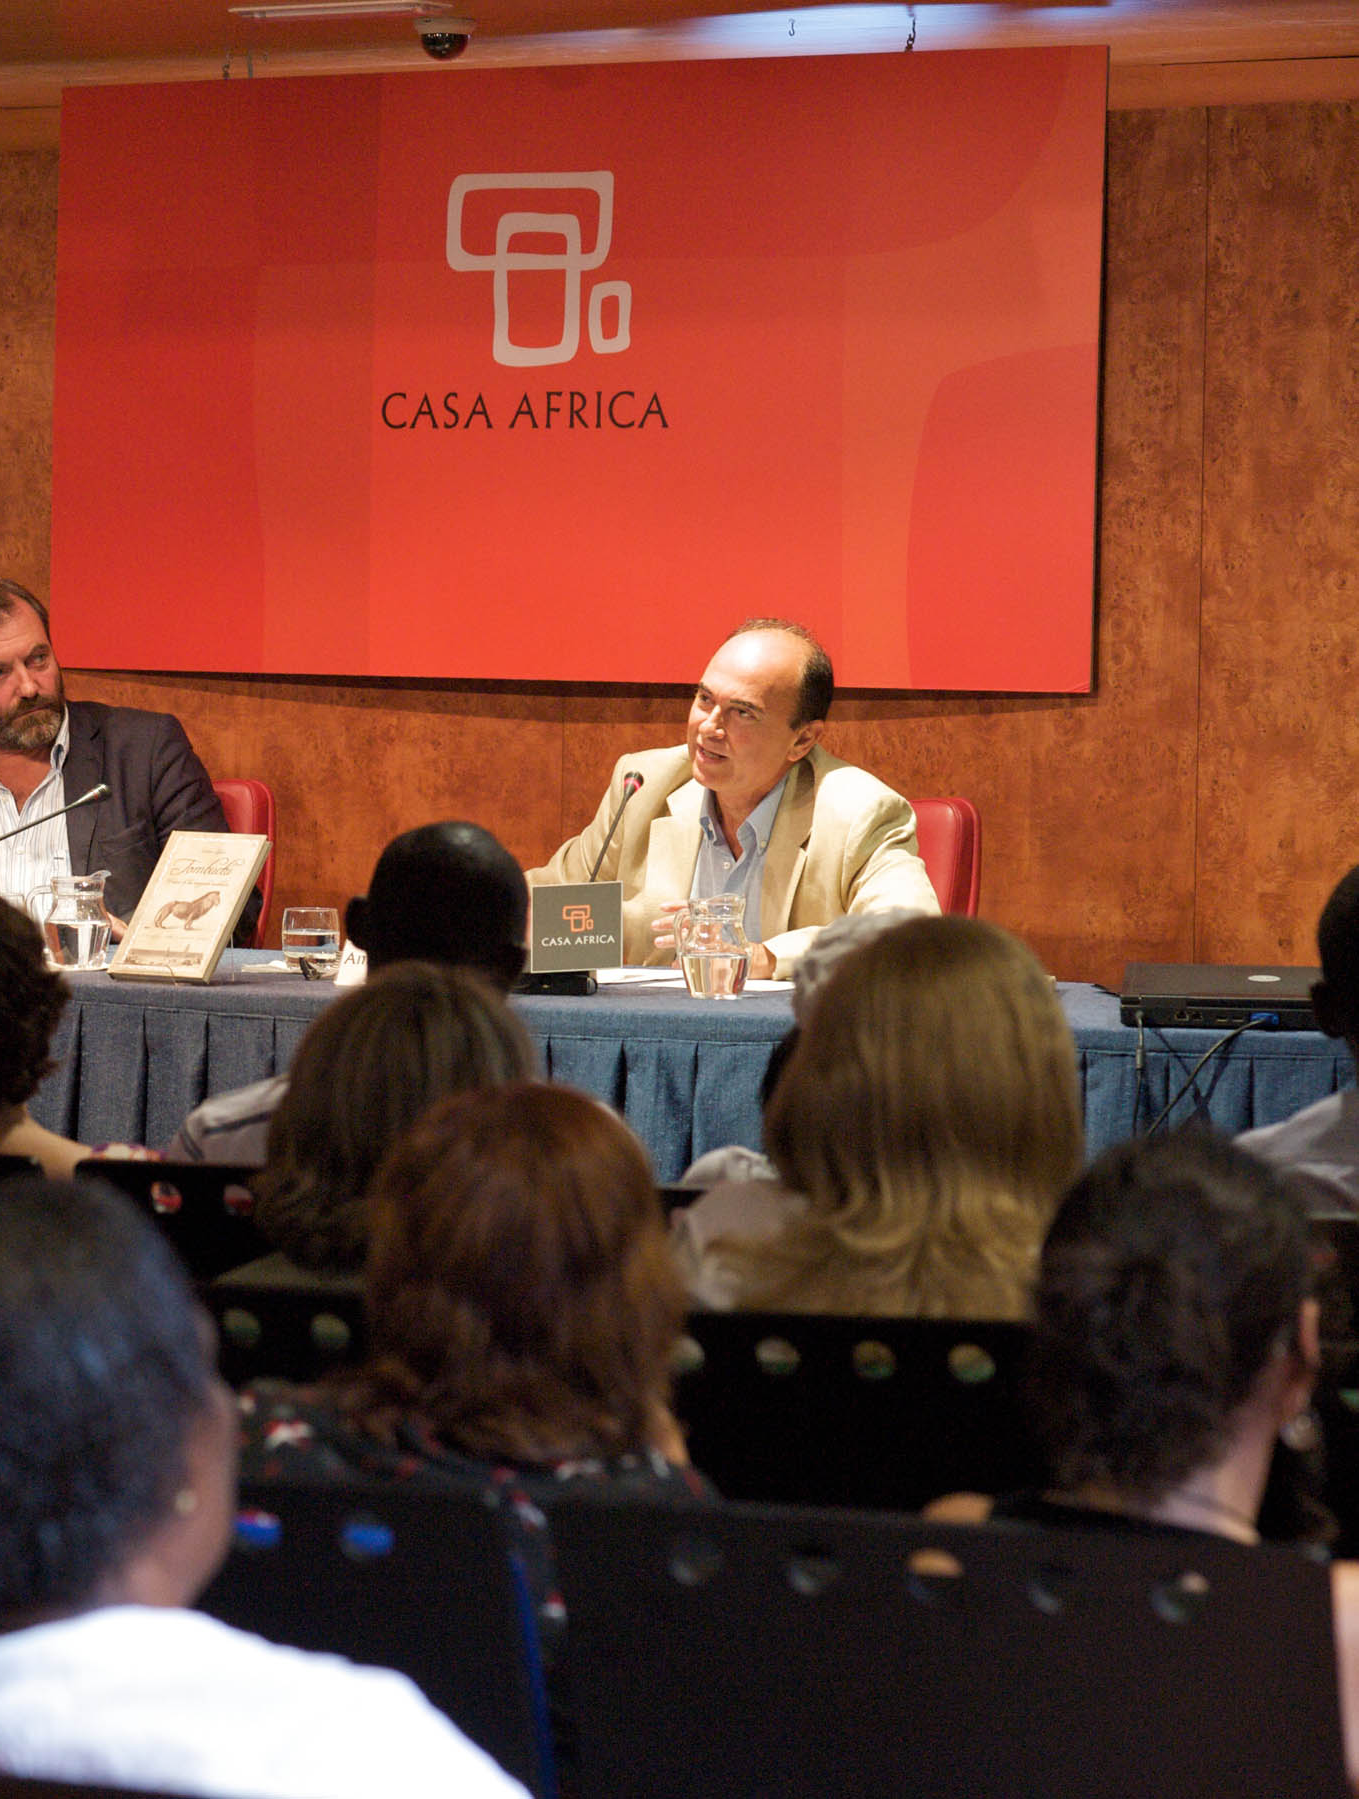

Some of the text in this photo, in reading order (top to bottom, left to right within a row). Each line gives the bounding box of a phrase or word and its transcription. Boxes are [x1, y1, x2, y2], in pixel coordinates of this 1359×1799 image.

[381, 390, 670, 430] CASA AFRICA
[541, 934, 616, 947] CASA AFRICA
